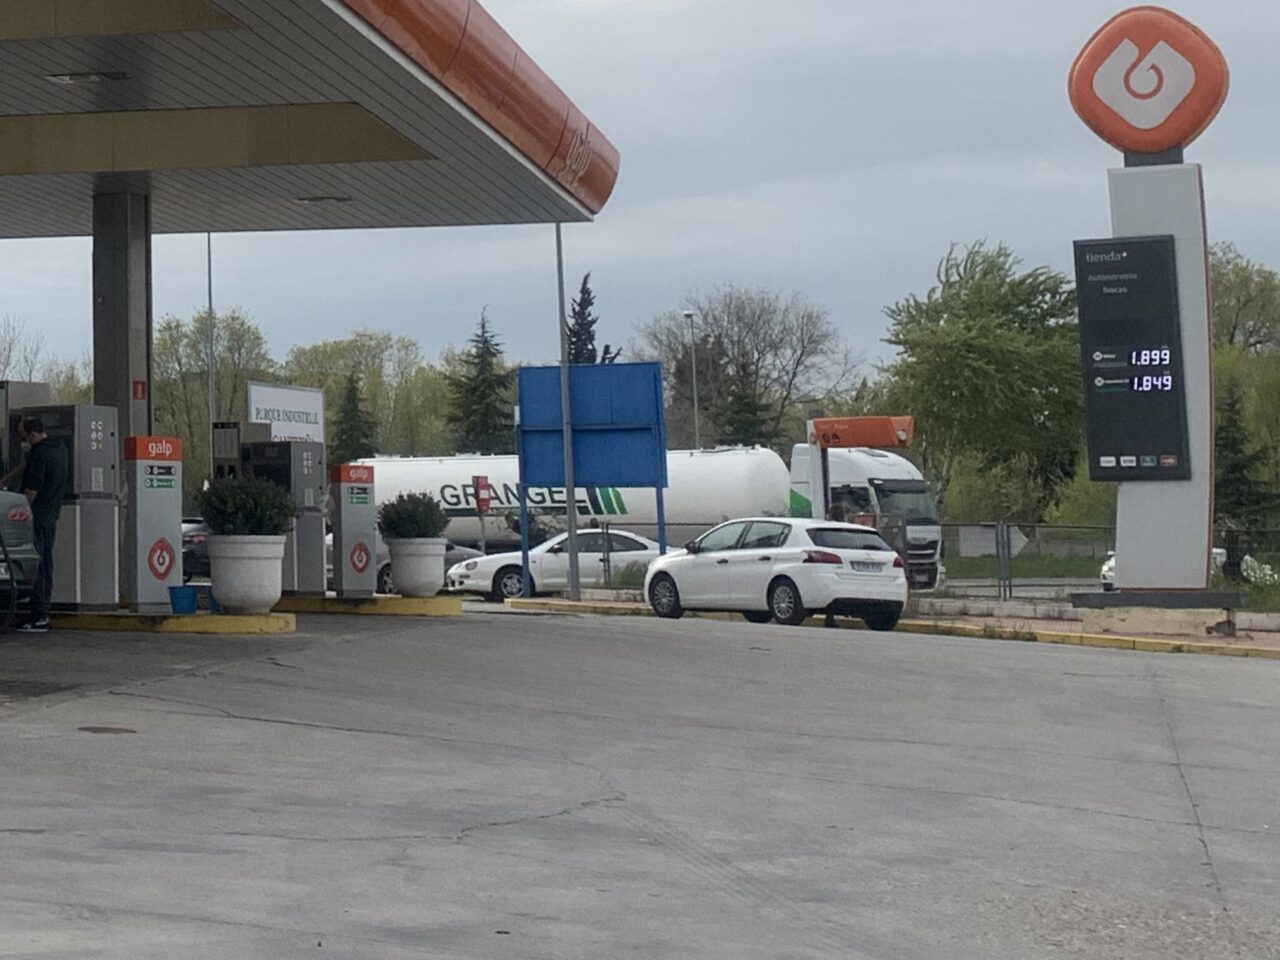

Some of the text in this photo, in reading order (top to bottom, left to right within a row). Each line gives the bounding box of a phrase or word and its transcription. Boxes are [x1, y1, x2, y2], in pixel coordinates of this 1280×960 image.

[1086, 251, 1121, 263] tienda
[1131, 349, 1170, 365] 1.899
[1133, 375, 1172, 391] 1.849
[148, 439, 173, 458] galp
[349, 467, 369, 481] galp
